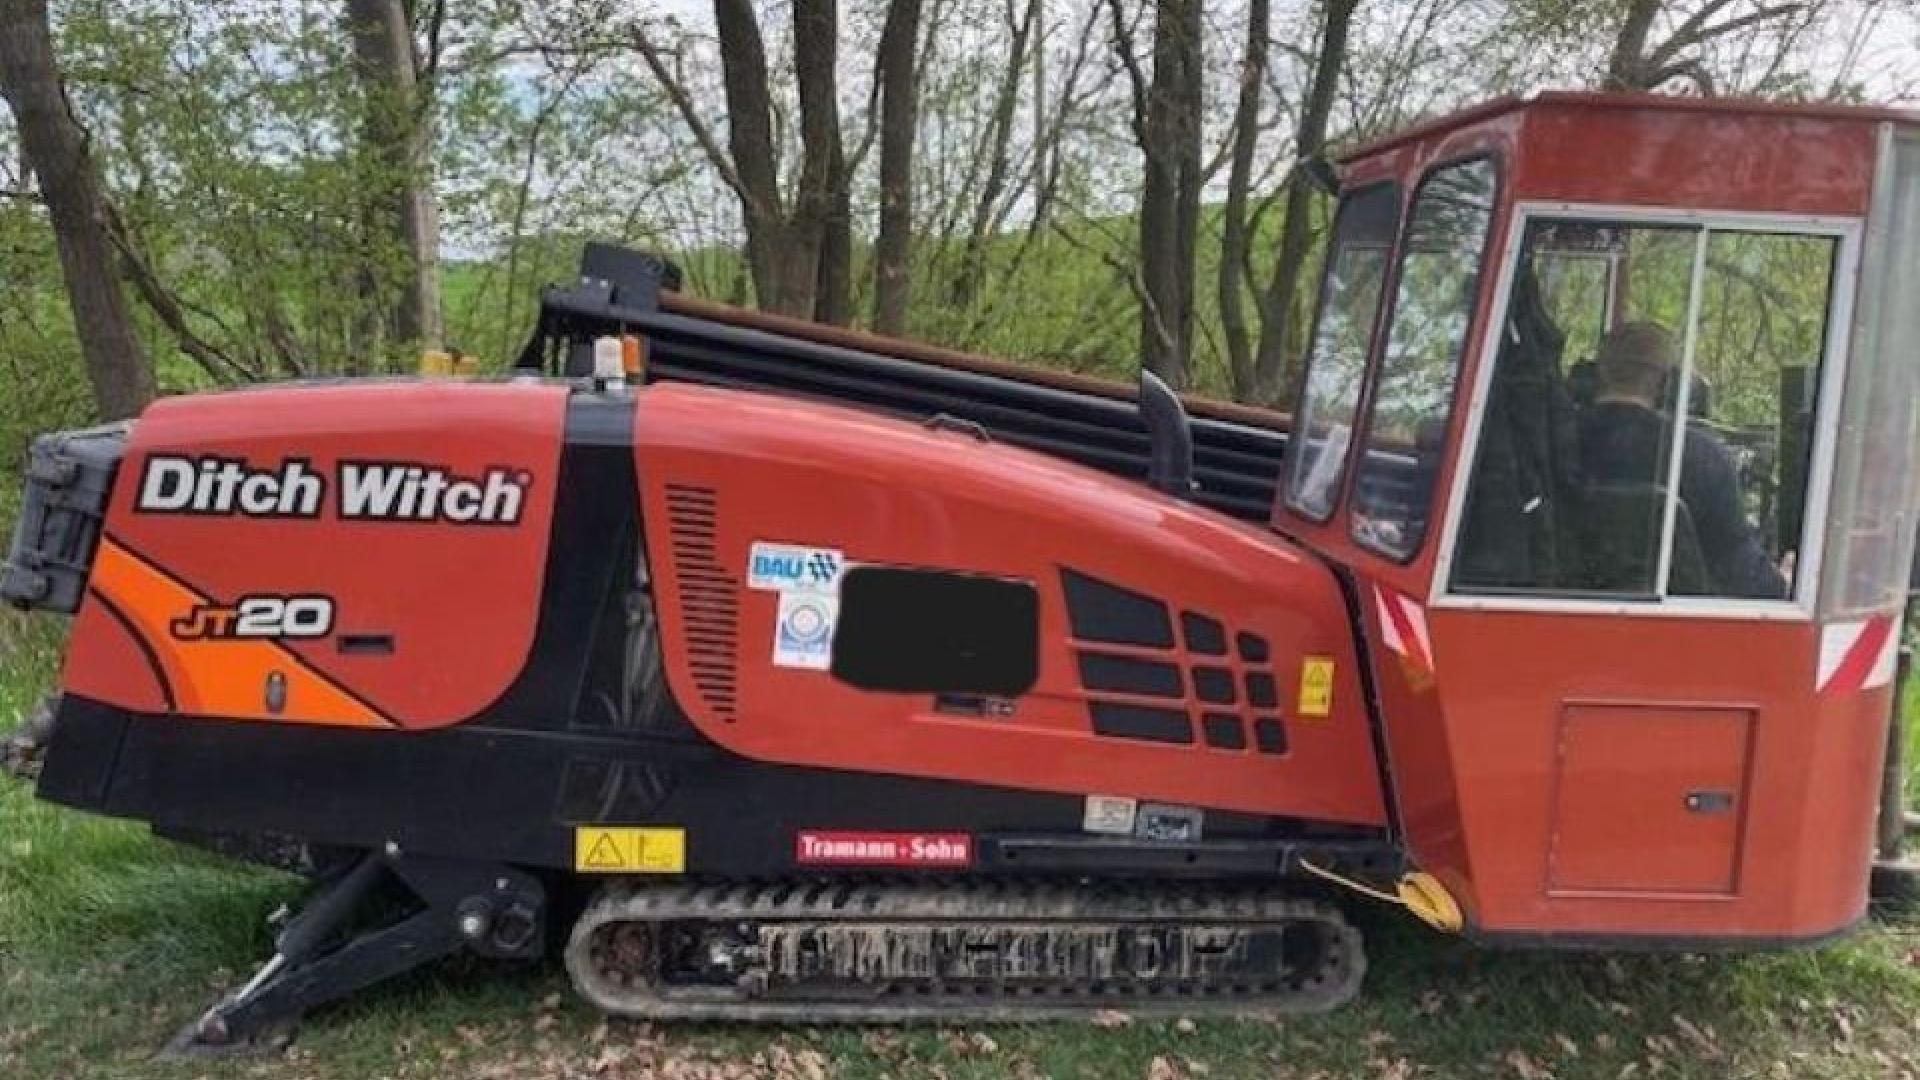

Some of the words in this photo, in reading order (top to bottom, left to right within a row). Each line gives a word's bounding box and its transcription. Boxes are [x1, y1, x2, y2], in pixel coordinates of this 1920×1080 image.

[138, 457, 322, 515] Ditch
[341, 464, 523, 521] Witch
[755, 555, 803, 578] BAU
[171, 597, 333, 638] JT20
[802, 835, 897, 858] Tramann
[910, 837, 967, 859] Sohn
